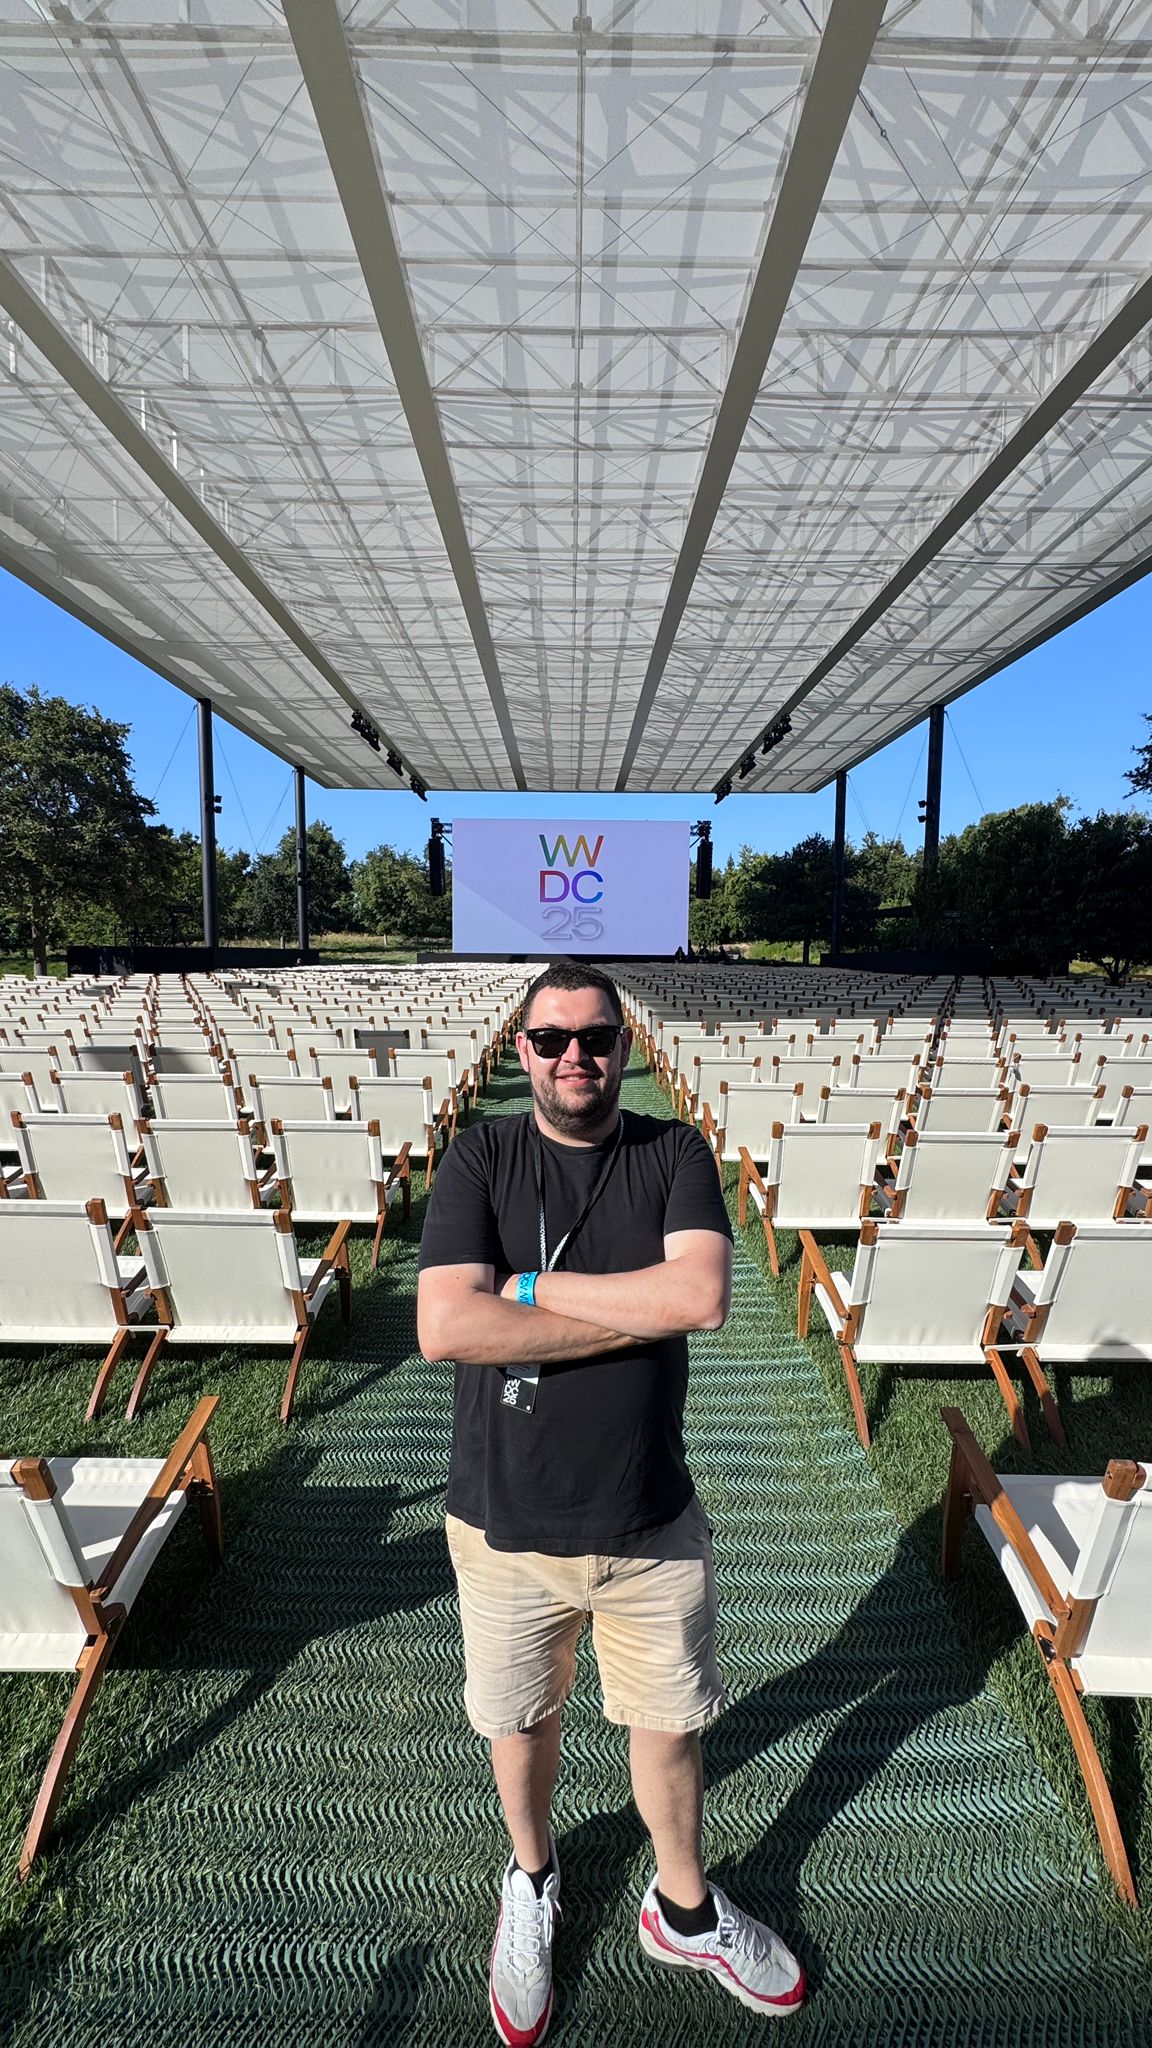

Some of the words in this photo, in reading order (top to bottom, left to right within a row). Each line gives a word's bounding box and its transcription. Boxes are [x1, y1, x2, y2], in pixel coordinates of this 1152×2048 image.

[538, 834, 604, 867] WW
[539, 870, 604, 903] DC
[540, 906, 604, 941] 25
[503, 1393, 517, 1405] 25
[504, 1384, 519, 1397] DC
